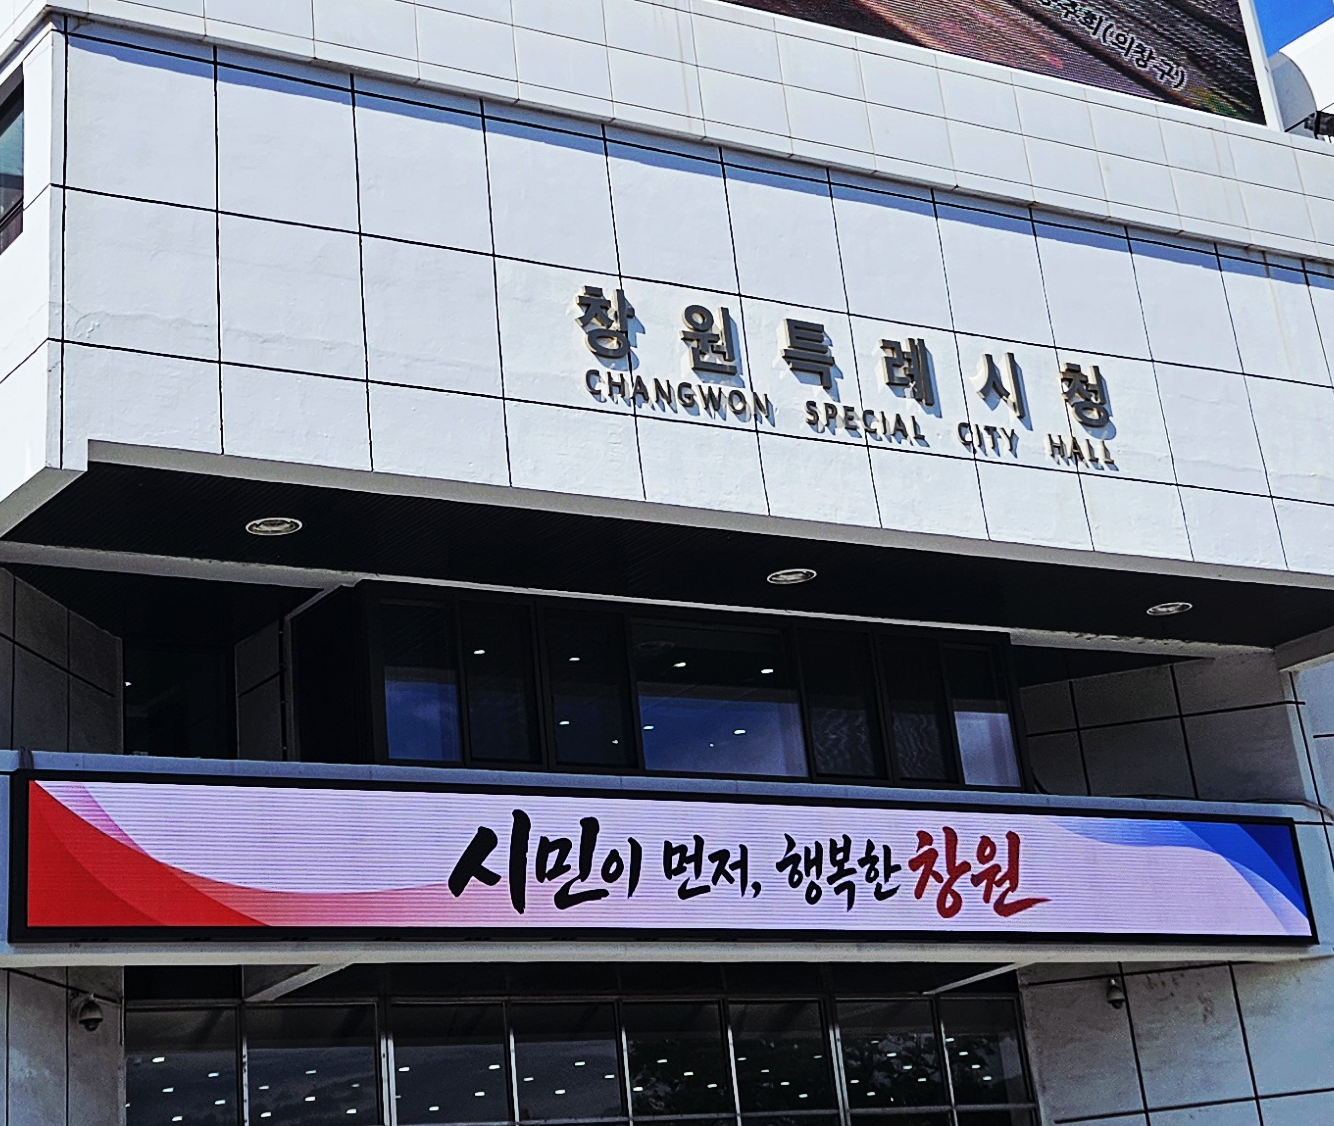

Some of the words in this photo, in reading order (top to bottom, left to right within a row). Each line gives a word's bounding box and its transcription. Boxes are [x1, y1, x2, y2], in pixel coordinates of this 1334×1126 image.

[576, 286, 1111, 429] 창원특례시청
[585, 369, 770, 419] CHANGWON
[806, 400, 926, 442] SPECIAL
[957, 422, 1017, 453] CITY
[1048, 434, 1116, 466] HALL
[448, 809, 642, 915] 시민이
[663, 834, 761, 900] 먼저,
[776, 833, 902, 912] 행복한
[909, 826, 1052, 918] 창원
